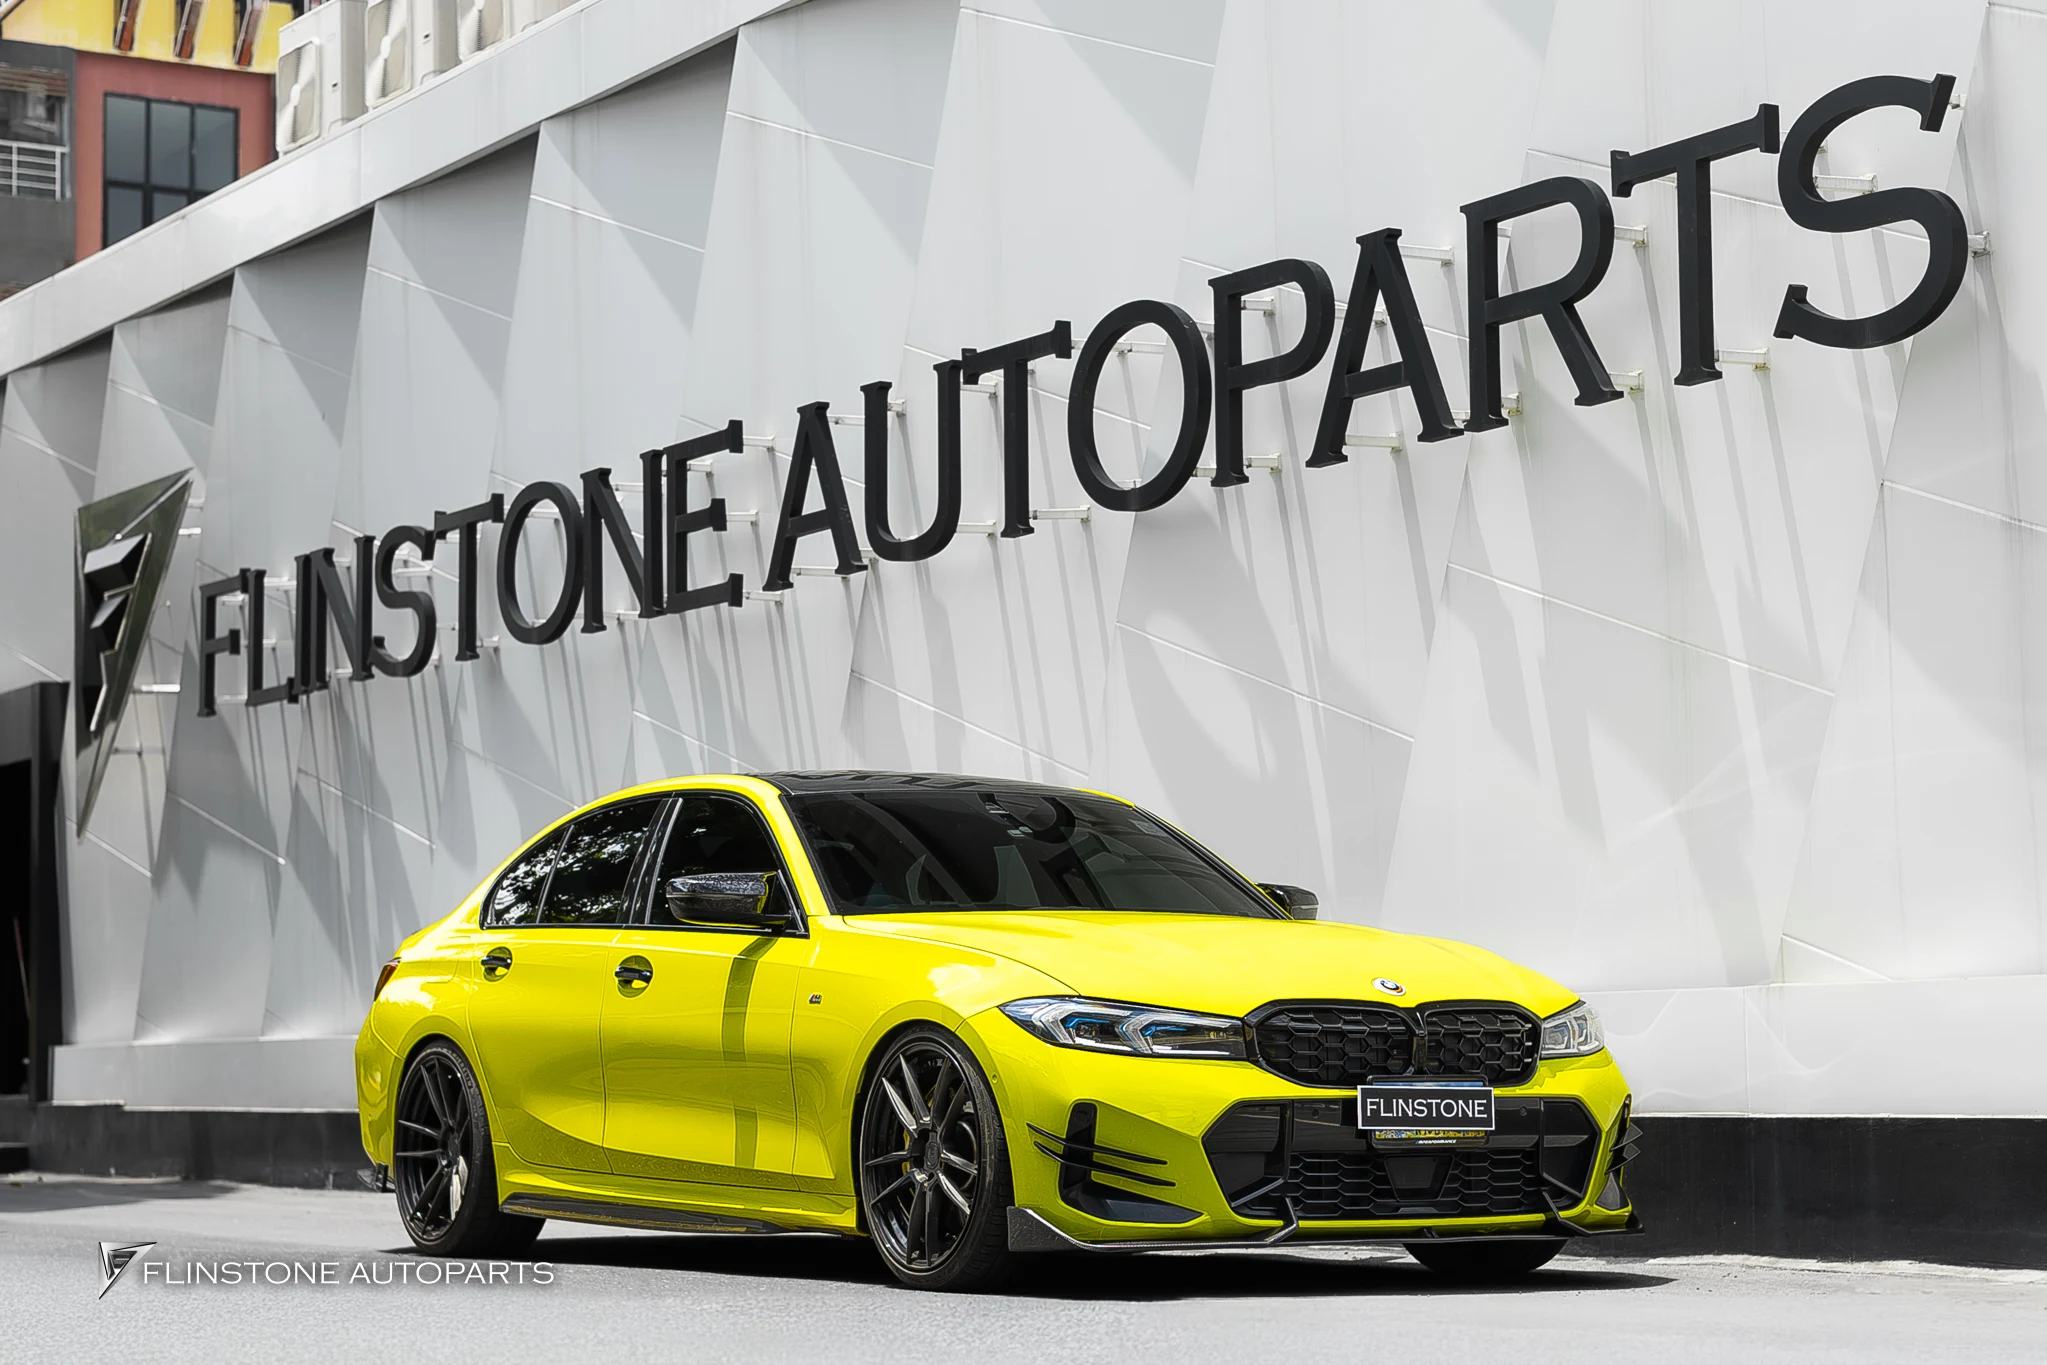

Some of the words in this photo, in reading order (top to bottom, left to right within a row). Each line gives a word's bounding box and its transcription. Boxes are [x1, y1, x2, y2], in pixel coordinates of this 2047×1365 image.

[197, 419, 743, 717] FLINSTONE
[762, 73, 1969, 590] AUTOPARTS
[1366, 1098, 1488, 1118] FLINSTONE
